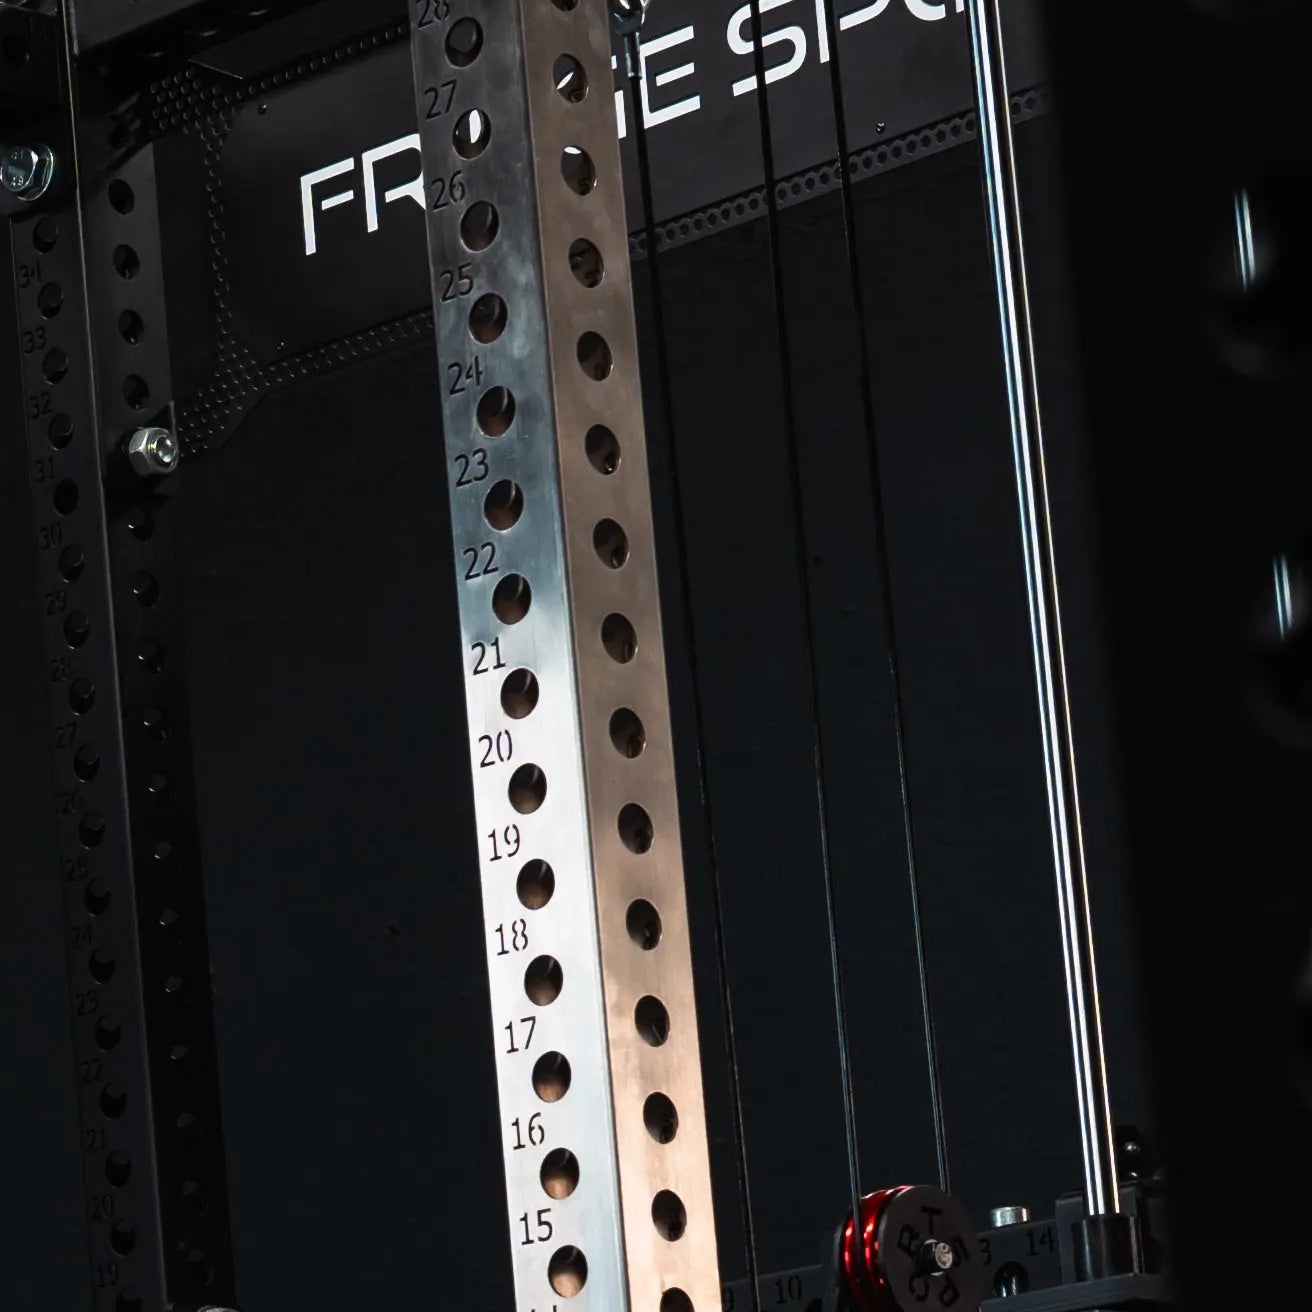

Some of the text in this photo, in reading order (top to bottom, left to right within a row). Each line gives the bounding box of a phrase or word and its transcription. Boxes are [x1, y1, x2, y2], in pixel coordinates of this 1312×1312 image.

[424, 80, 458, 121] 27
[432, 170, 465, 211] 26
[440, 262, 474, 303] 25
[24, 326, 47, 354] 33
[448, 355, 484, 396] 24
[29, 392, 52, 419] 32
[456, 448, 489, 487] 23
[463, 542, 498, 581] 22
[471, 637, 506, 675] 21
[478, 729, 513, 768] 20
[487, 823, 521, 862] 19
[495, 918, 529, 956] 18
[504, 1016, 537, 1054] 17
[511, 1112, 545, 1151] 16
[519, 1208, 554, 1246] 15
